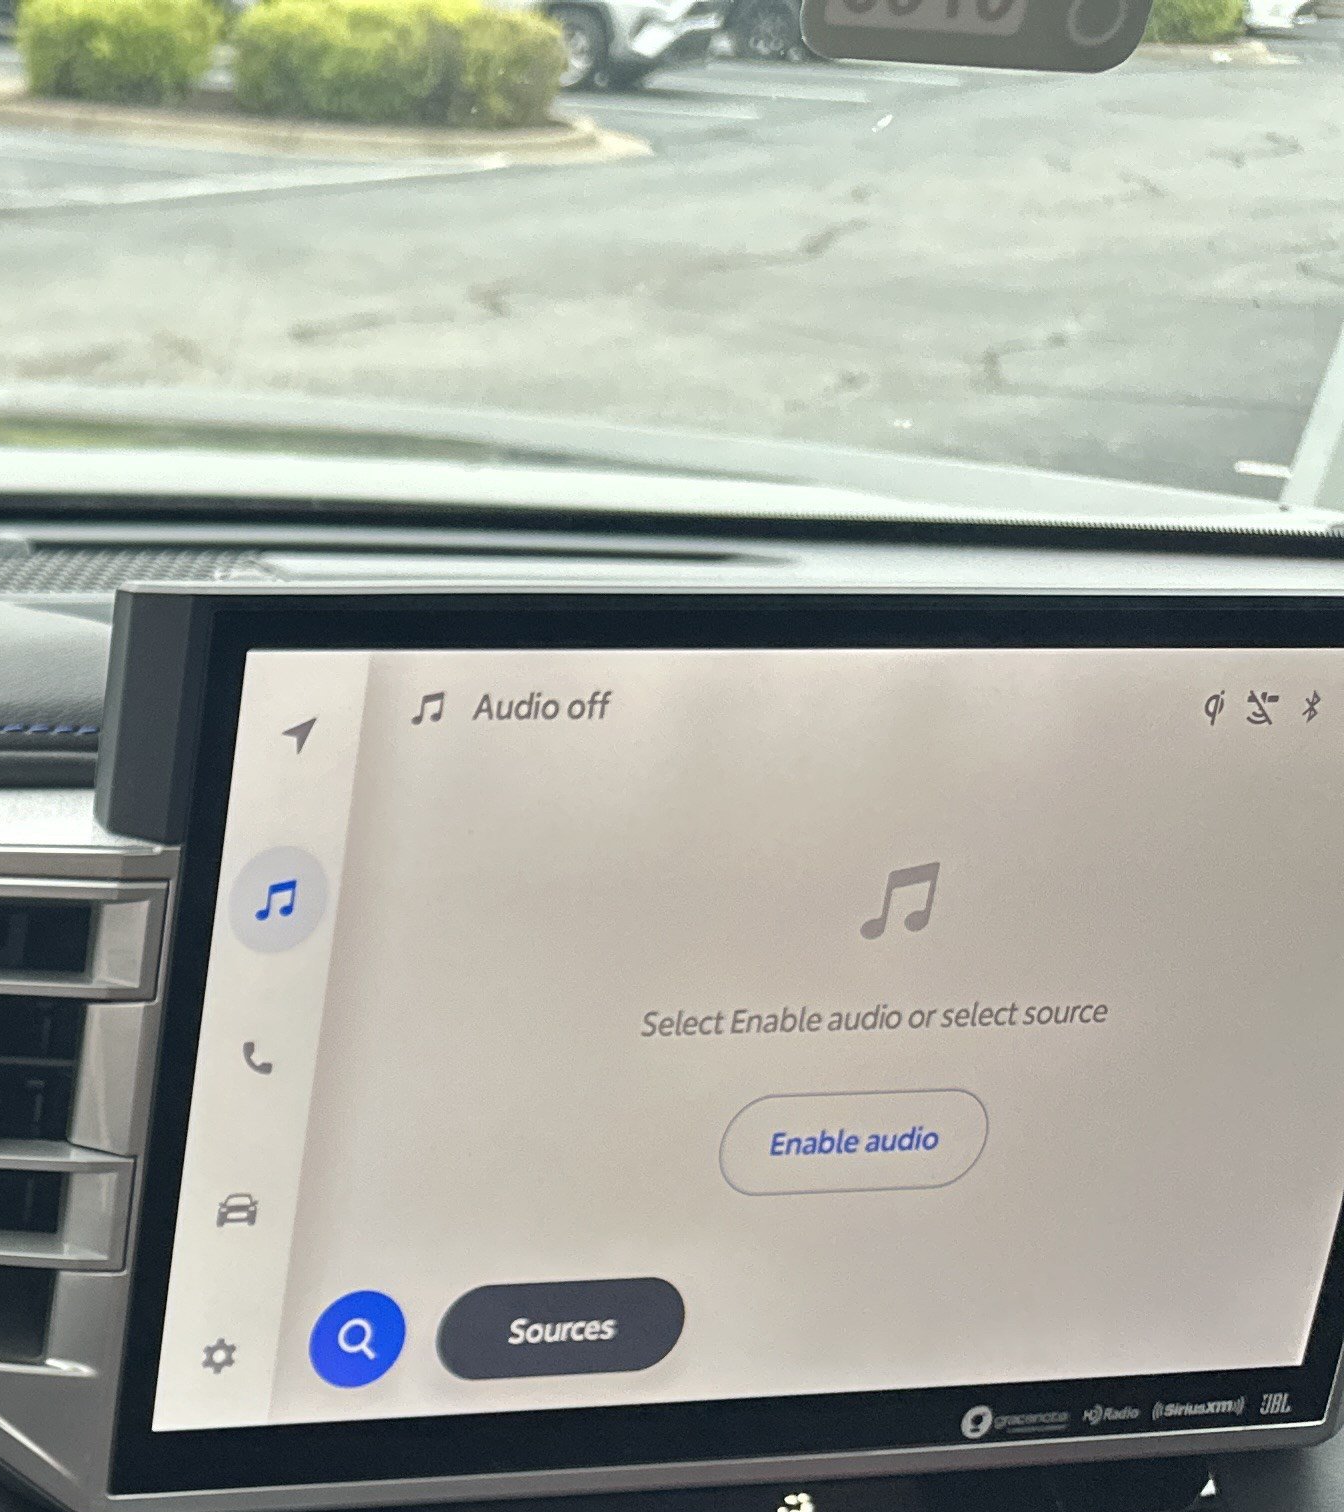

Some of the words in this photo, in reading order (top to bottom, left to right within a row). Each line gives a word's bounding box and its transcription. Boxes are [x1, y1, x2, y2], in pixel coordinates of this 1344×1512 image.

[471, 690, 560, 721] Audio
[567, 689, 613, 720] off
[640, 1009, 725, 1038] Select
[730, 1006, 822, 1035] Enable
[827, 1003, 901, 1033] audio
[908, 1009, 933, 1030] or
[940, 1000, 1018, 1028] select
[1021, 1002, 1109, 1026] source
[768, 1128, 860, 1157] Enable
[864, 1126, 940, 1154] audio
[508, 1317, 618, 1345] Sources
[1103, 1404, 1140, 1422] Radio
[1259, 1393, 1293, 1415] JBL
